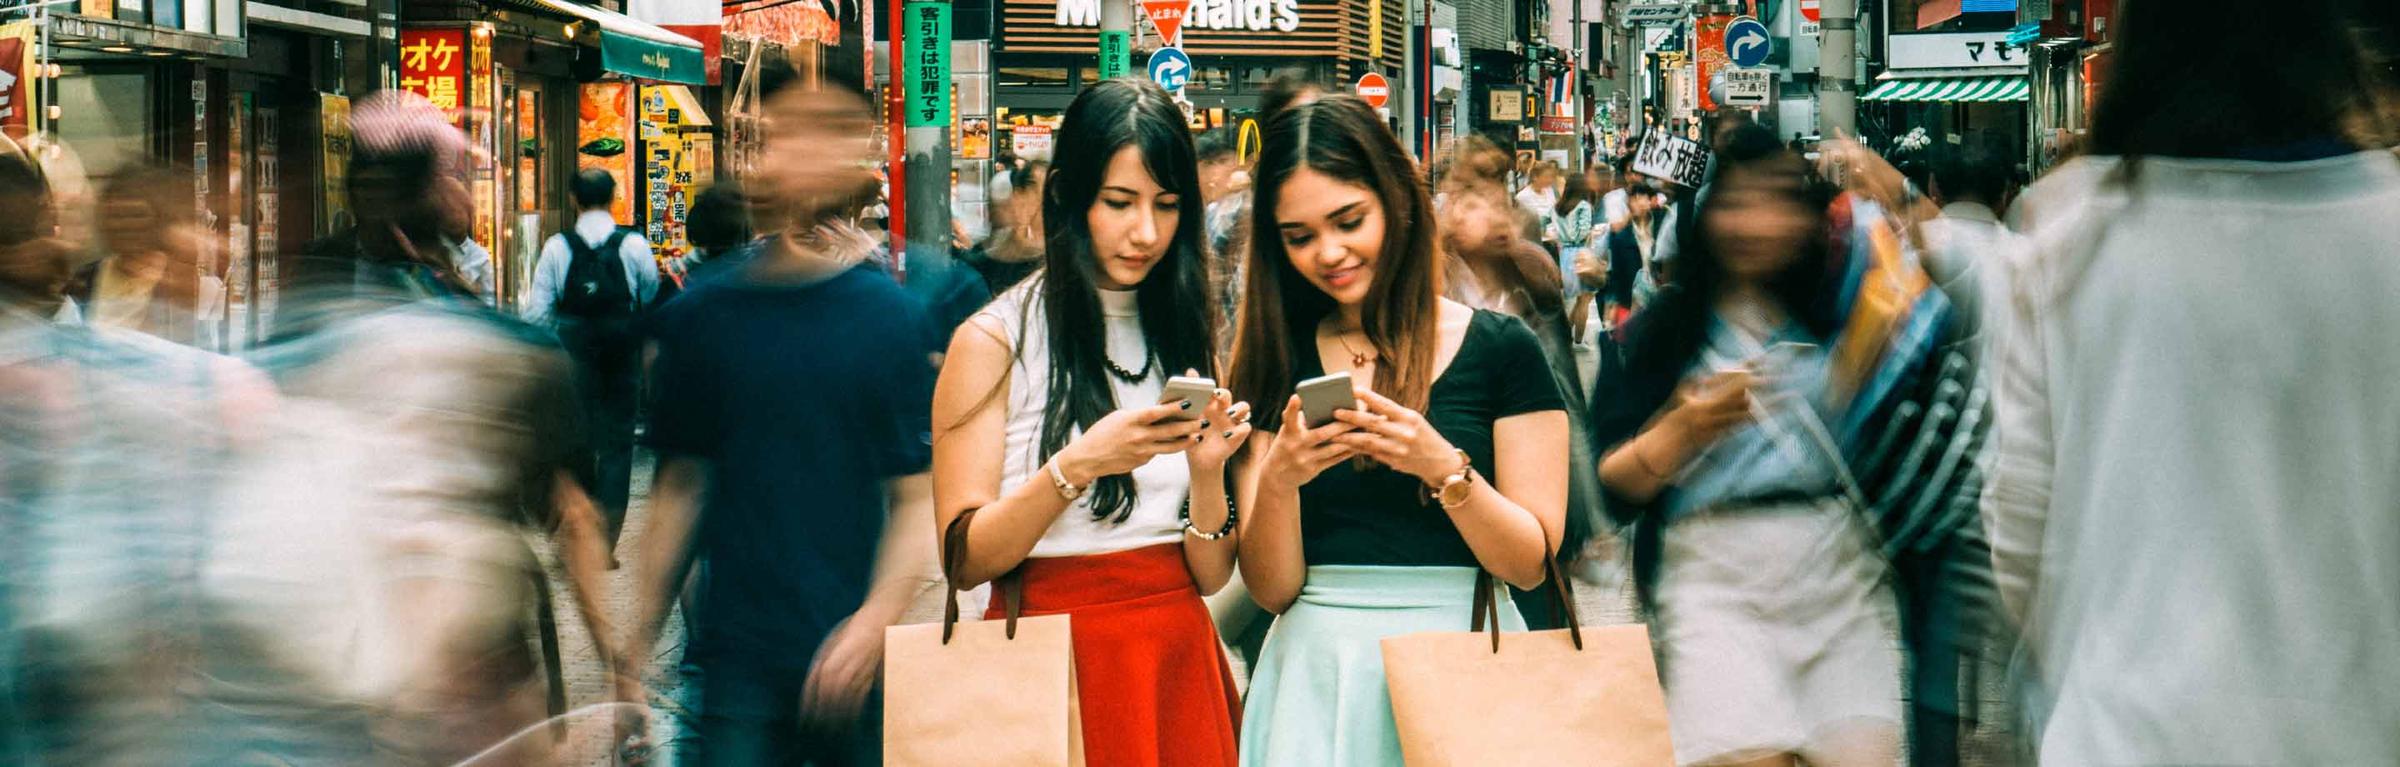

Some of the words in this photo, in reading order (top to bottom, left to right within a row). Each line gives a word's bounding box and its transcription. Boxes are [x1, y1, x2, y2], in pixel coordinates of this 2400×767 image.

[1055, 0, 1299, 32] Mnalds
[1152, 8, 1182, 19] 止まれ
[920, 7, 940, 121] 客引きは犯罪です
[1727, 83, 1767, 92] 一方通行
[1639, 127, 1709, 188] 飲み放題
